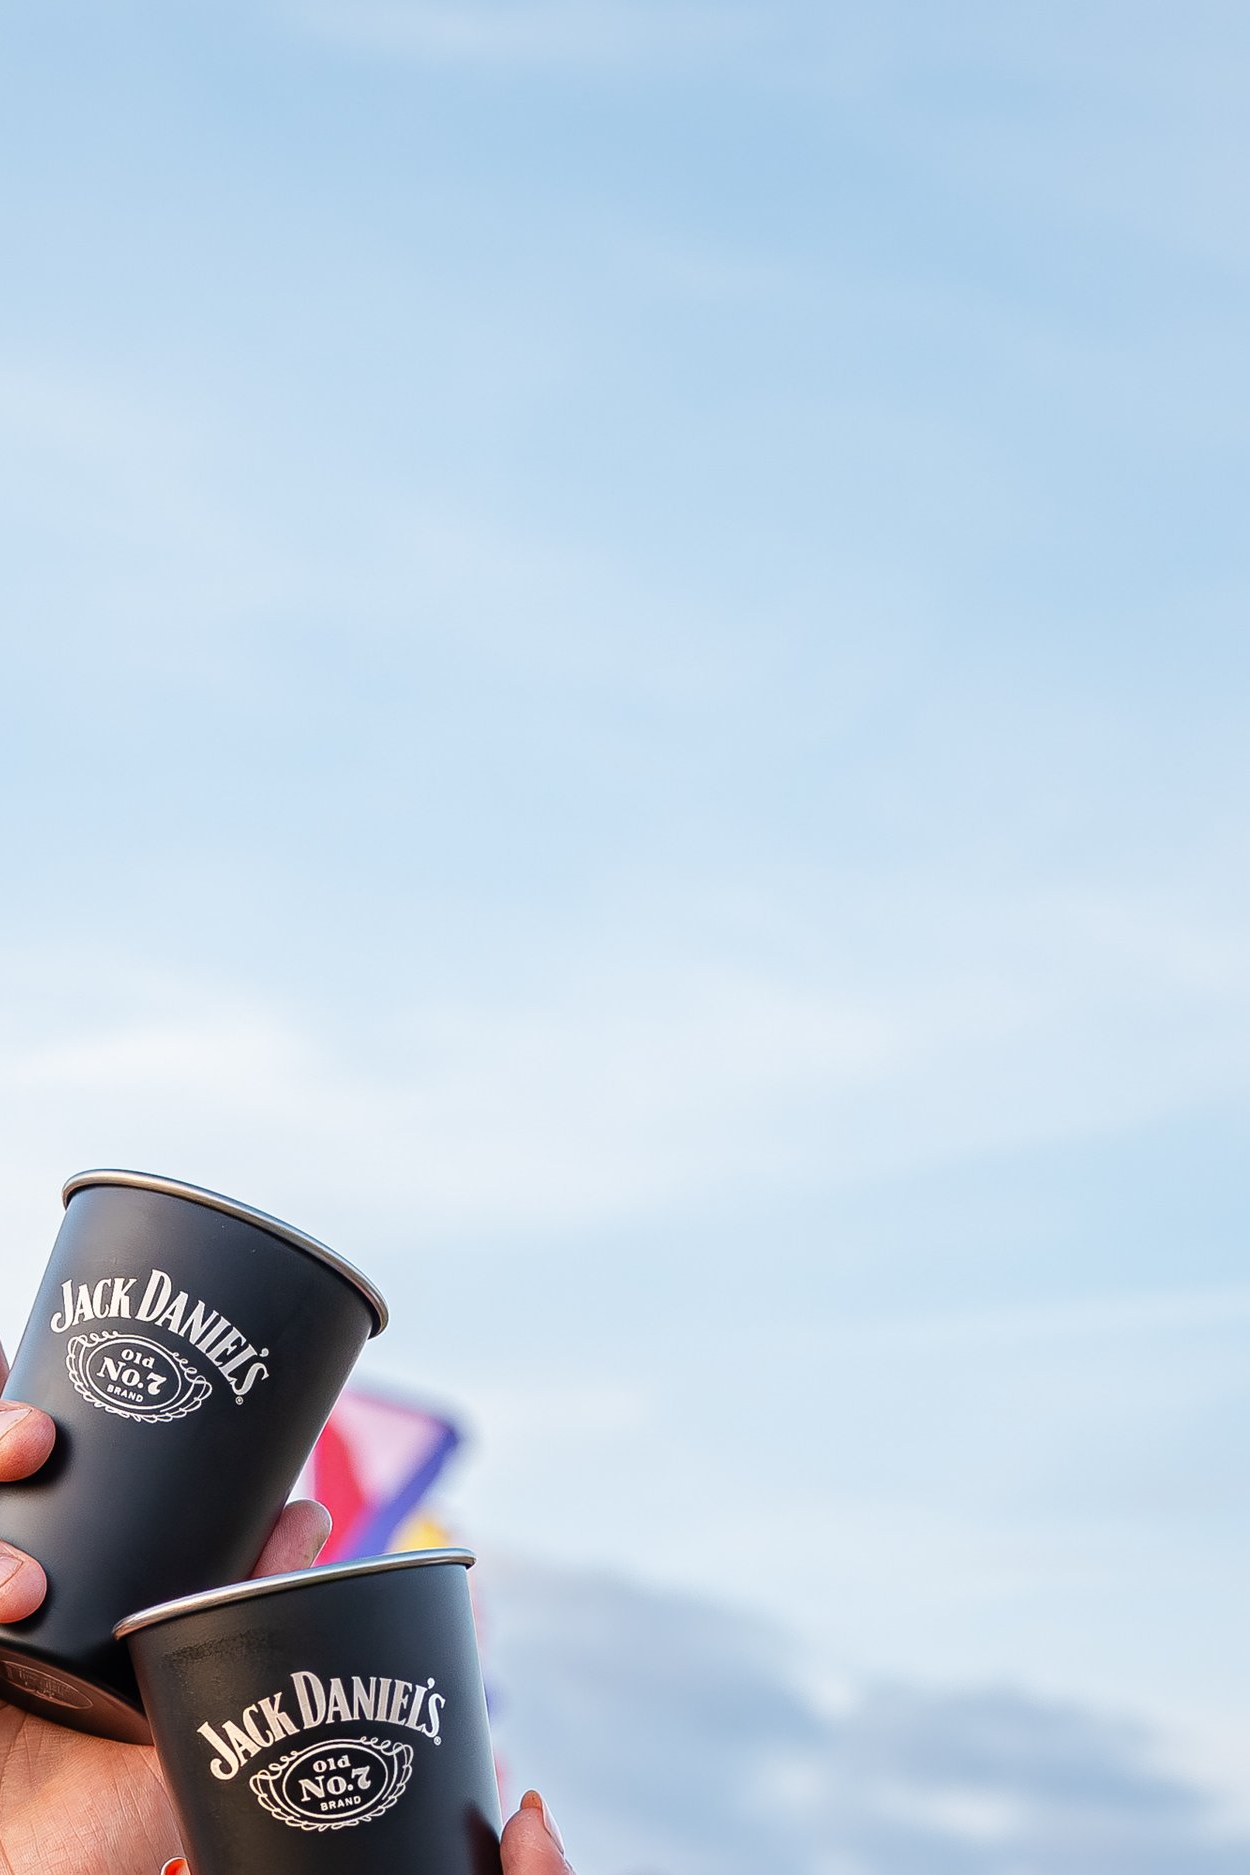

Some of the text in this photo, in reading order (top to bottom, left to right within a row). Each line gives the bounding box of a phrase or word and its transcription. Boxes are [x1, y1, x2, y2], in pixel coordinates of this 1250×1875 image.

[50, 1268, 270, 1396] JACK DANIEL'S
[121, 1349, 155, 1369] Old
[106, 1384, 144, 1403] BRAND
[197, 1670, 446, 1781] JACK DANIEL'S
[312, 1754, 351, 1773] Old
[320, 1795, 361, 1812] BRAND
